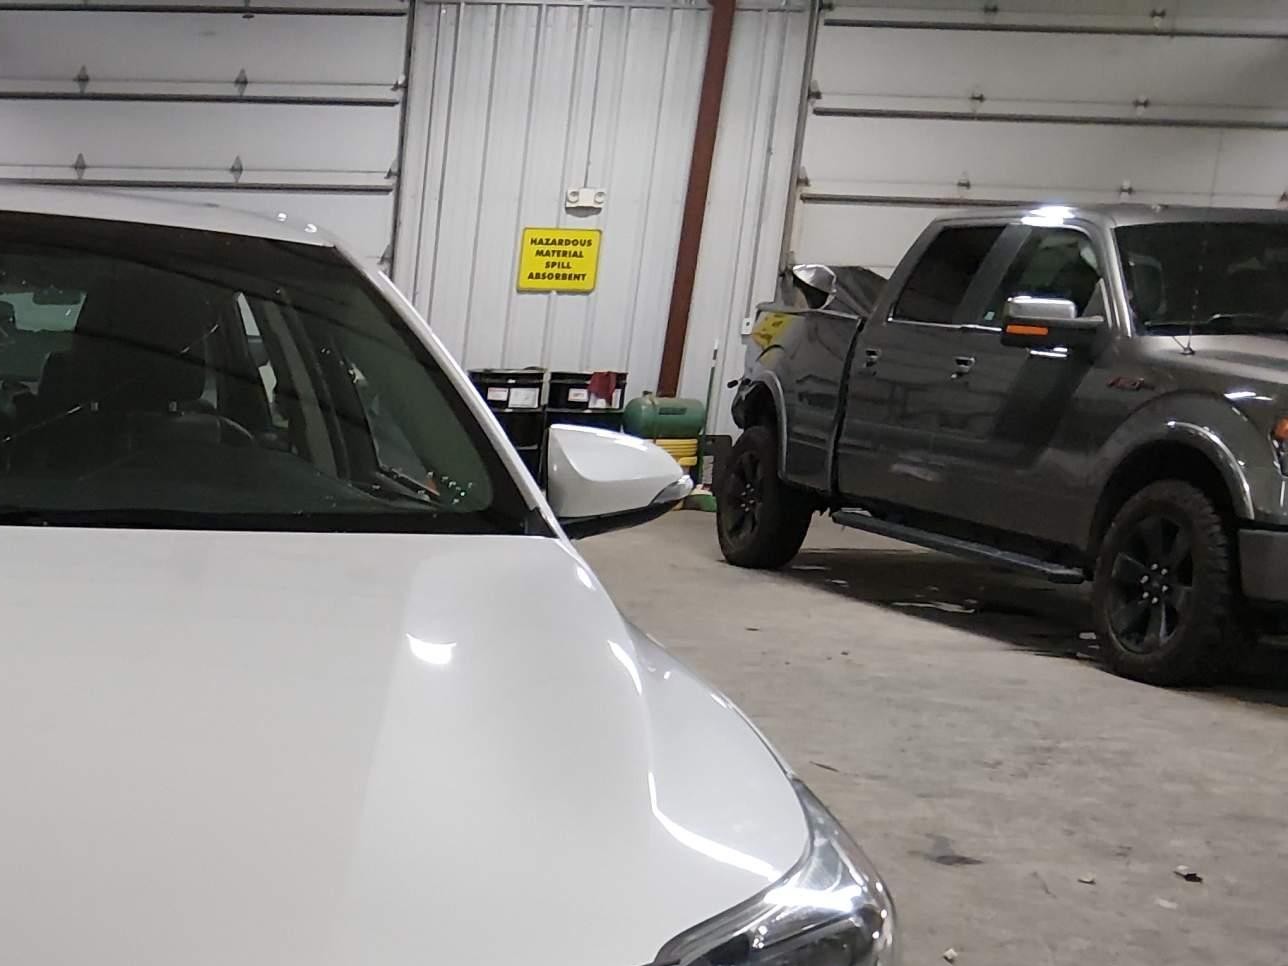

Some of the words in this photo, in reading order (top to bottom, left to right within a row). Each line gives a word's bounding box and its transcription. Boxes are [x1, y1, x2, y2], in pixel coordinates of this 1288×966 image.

[530, 238, 592, 247] HAZARDOUS
[535, 250, 584, 258] MATERIAL
[545, 261, 572, 269] SPILL
[528, 272, 587, 281] ABSORBENT
